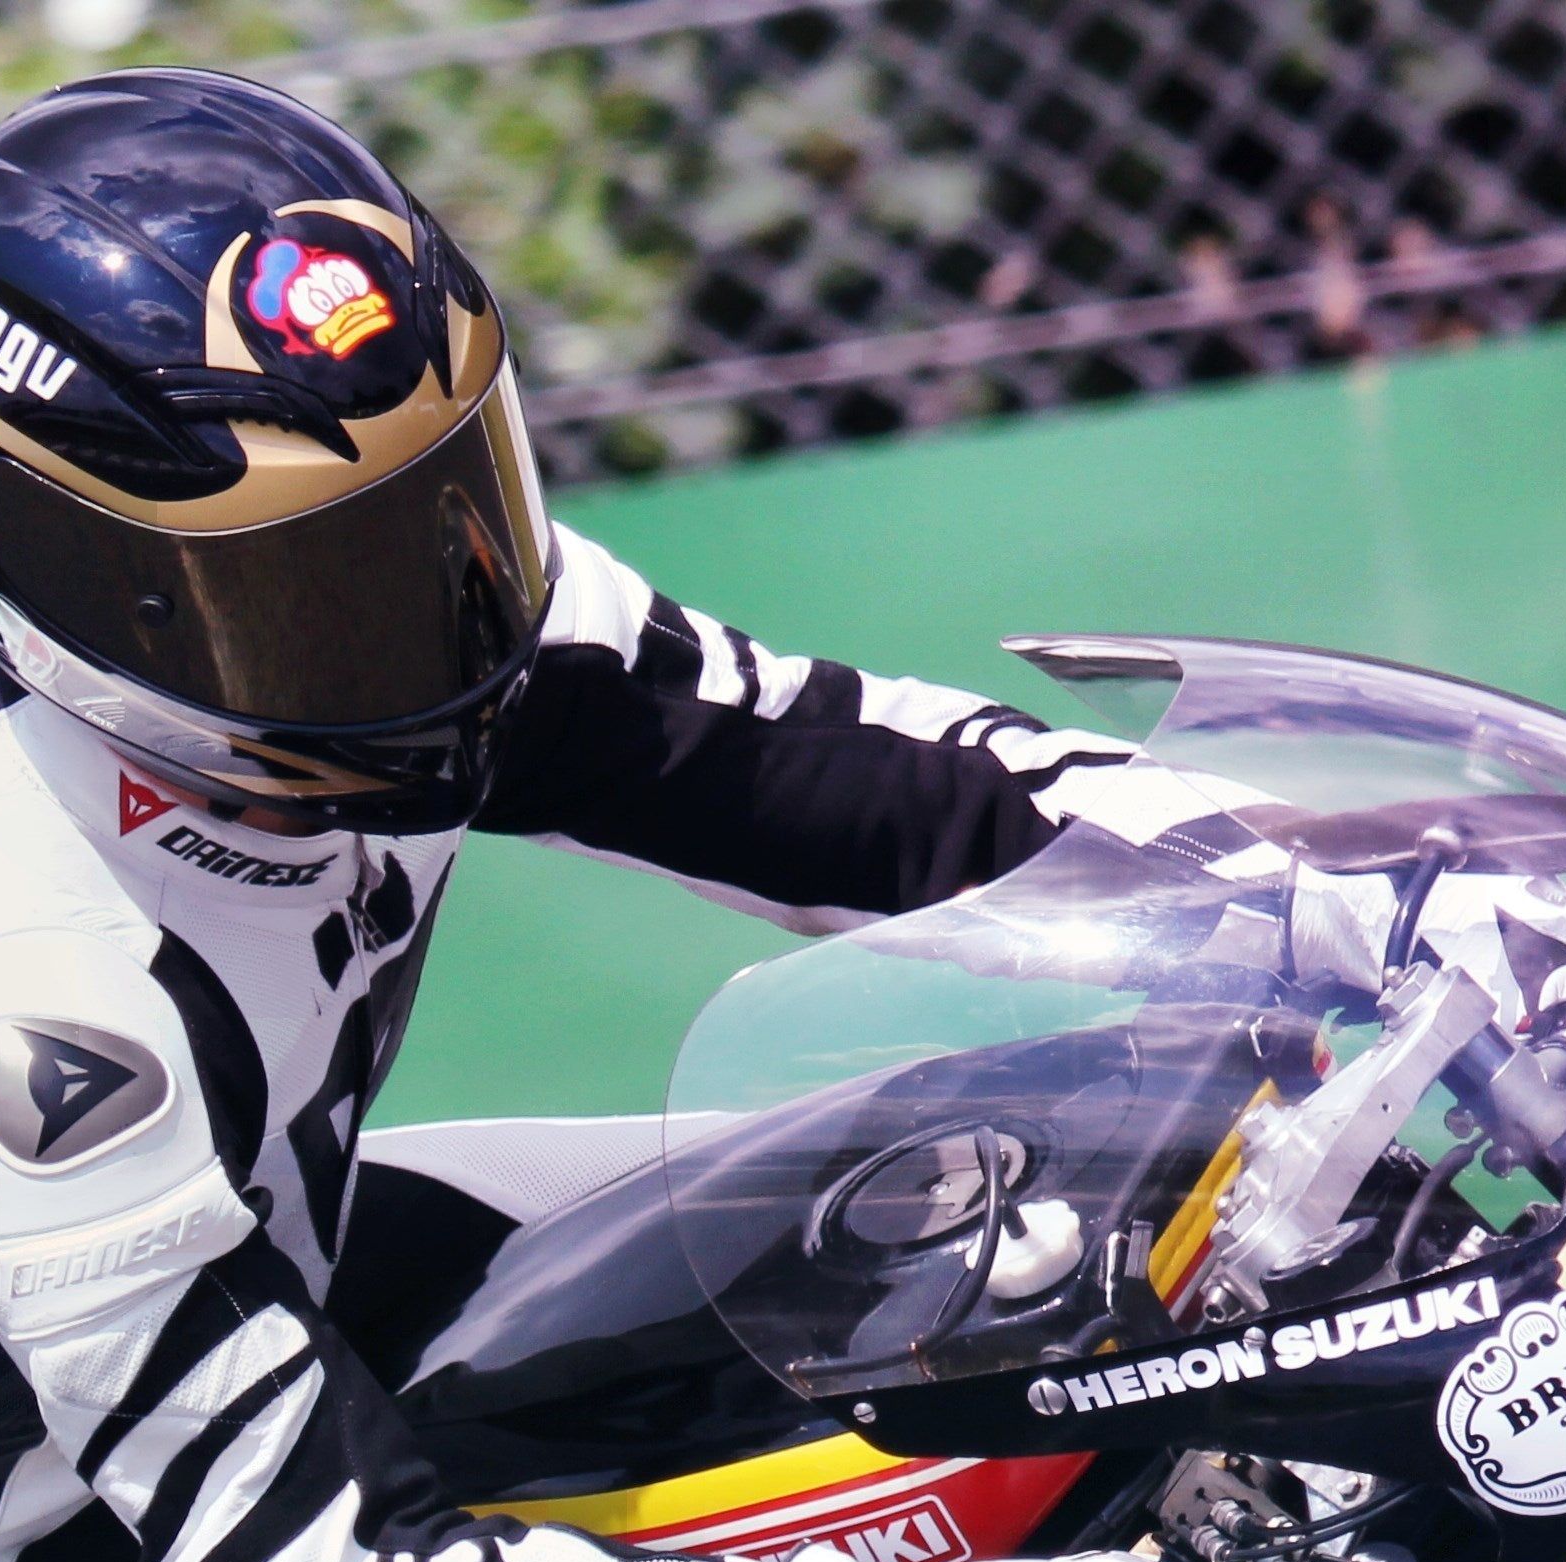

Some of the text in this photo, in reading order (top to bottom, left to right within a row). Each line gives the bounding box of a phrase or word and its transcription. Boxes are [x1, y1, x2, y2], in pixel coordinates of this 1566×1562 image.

[156, 826, 339, 887] DAINESE
[11, 1206, 204, 1299] DAINESE
[1064, 1276, 1500, 1413] HERON SUZUKI
